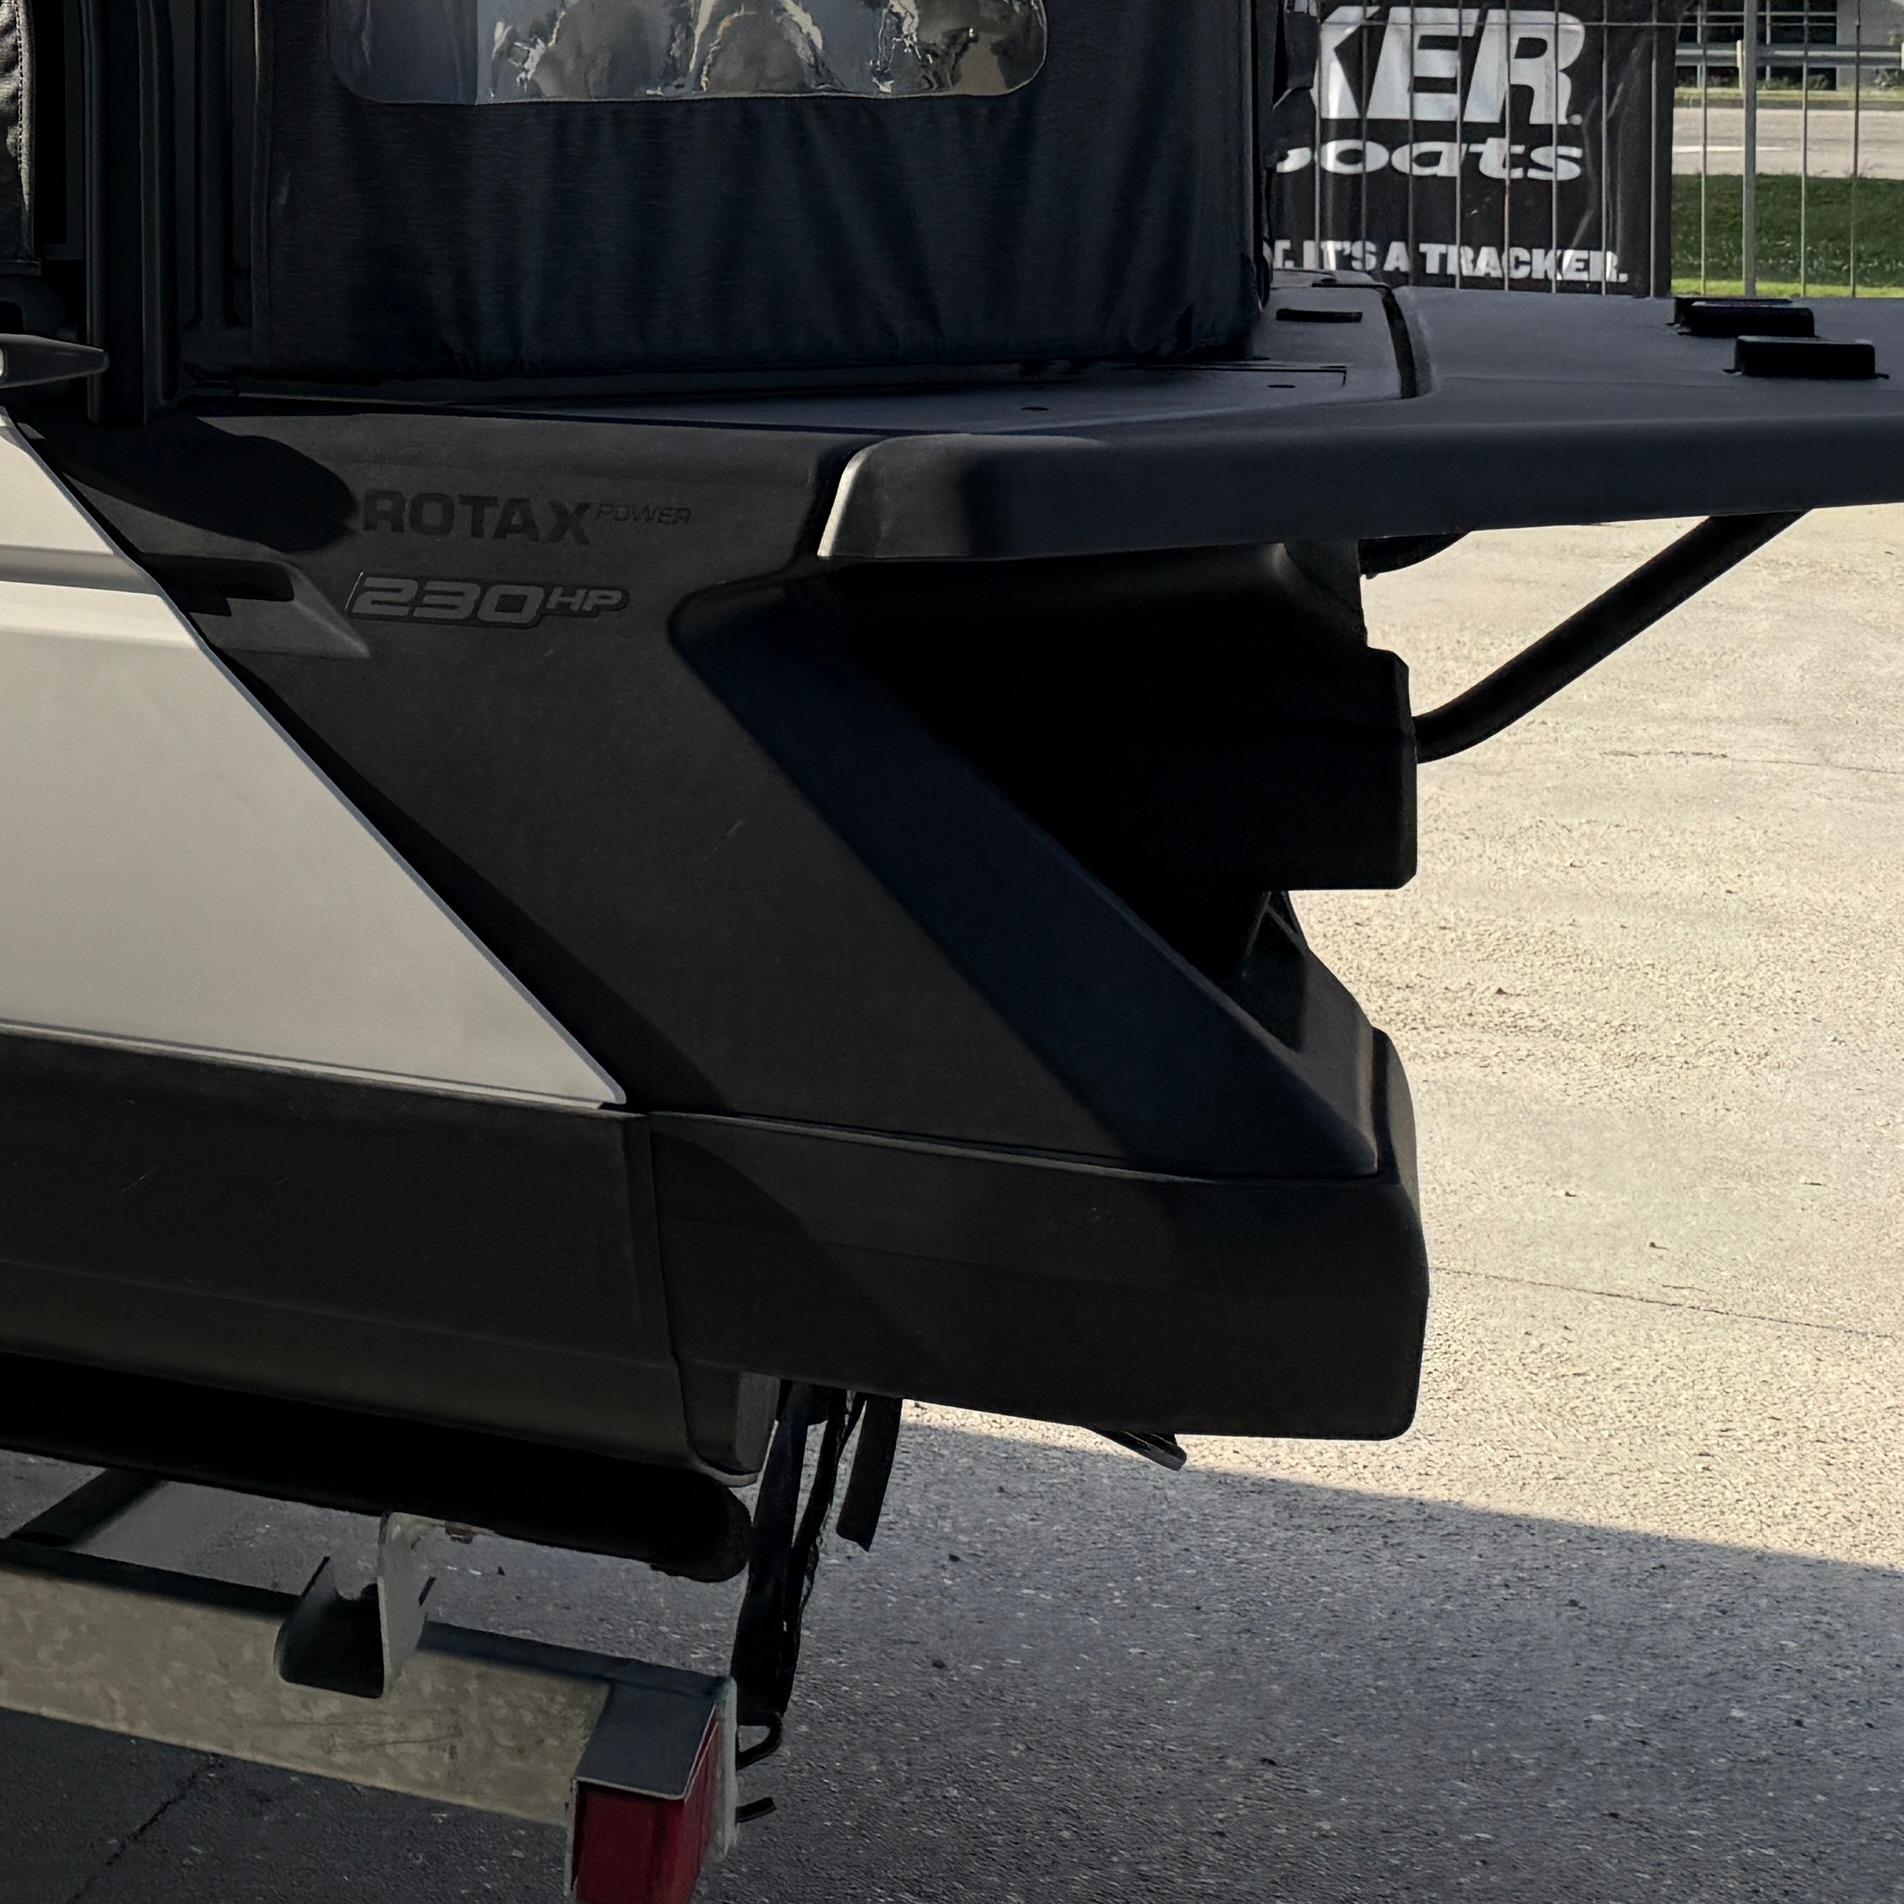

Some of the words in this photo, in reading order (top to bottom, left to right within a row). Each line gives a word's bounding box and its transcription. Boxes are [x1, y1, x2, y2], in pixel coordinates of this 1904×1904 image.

[1311, 5, 1585, 124] KER
[1303, 239, 1377, 272] IT'S
[1383, 241, 1411, 273] A
[1419, 243, 1629, 284] TRACKER.
[363, 489, 591, 545] ROTAX
[595, 502, 693, 526] POWER
